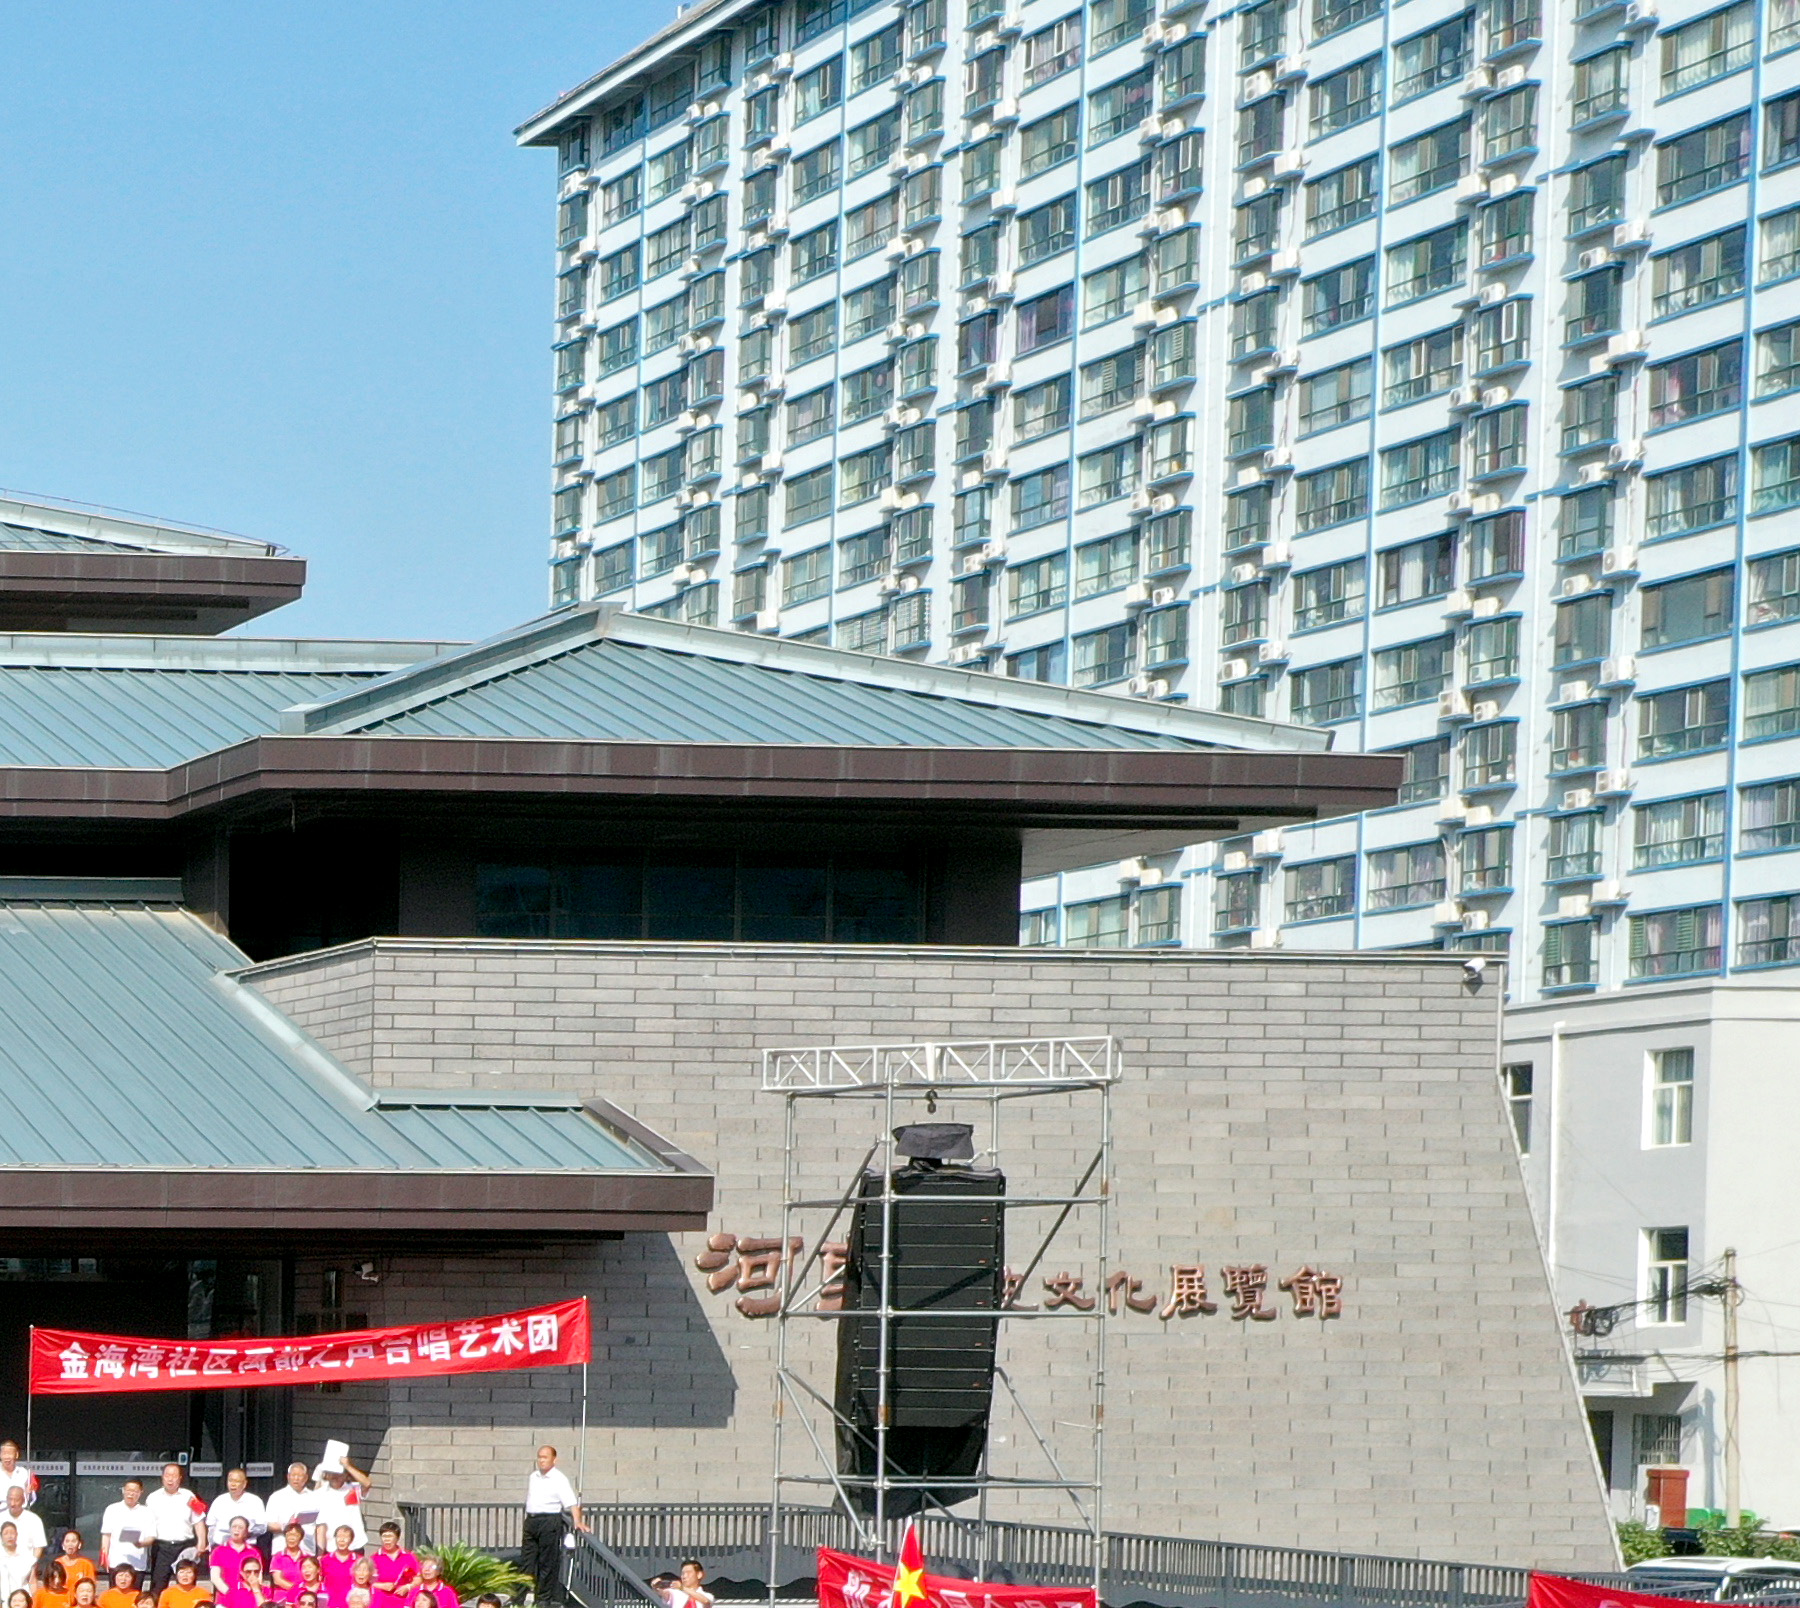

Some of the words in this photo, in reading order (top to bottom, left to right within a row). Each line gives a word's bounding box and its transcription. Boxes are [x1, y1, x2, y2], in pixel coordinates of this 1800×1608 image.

[695, 1232, 1344, 1320] 河史文化展覽館
